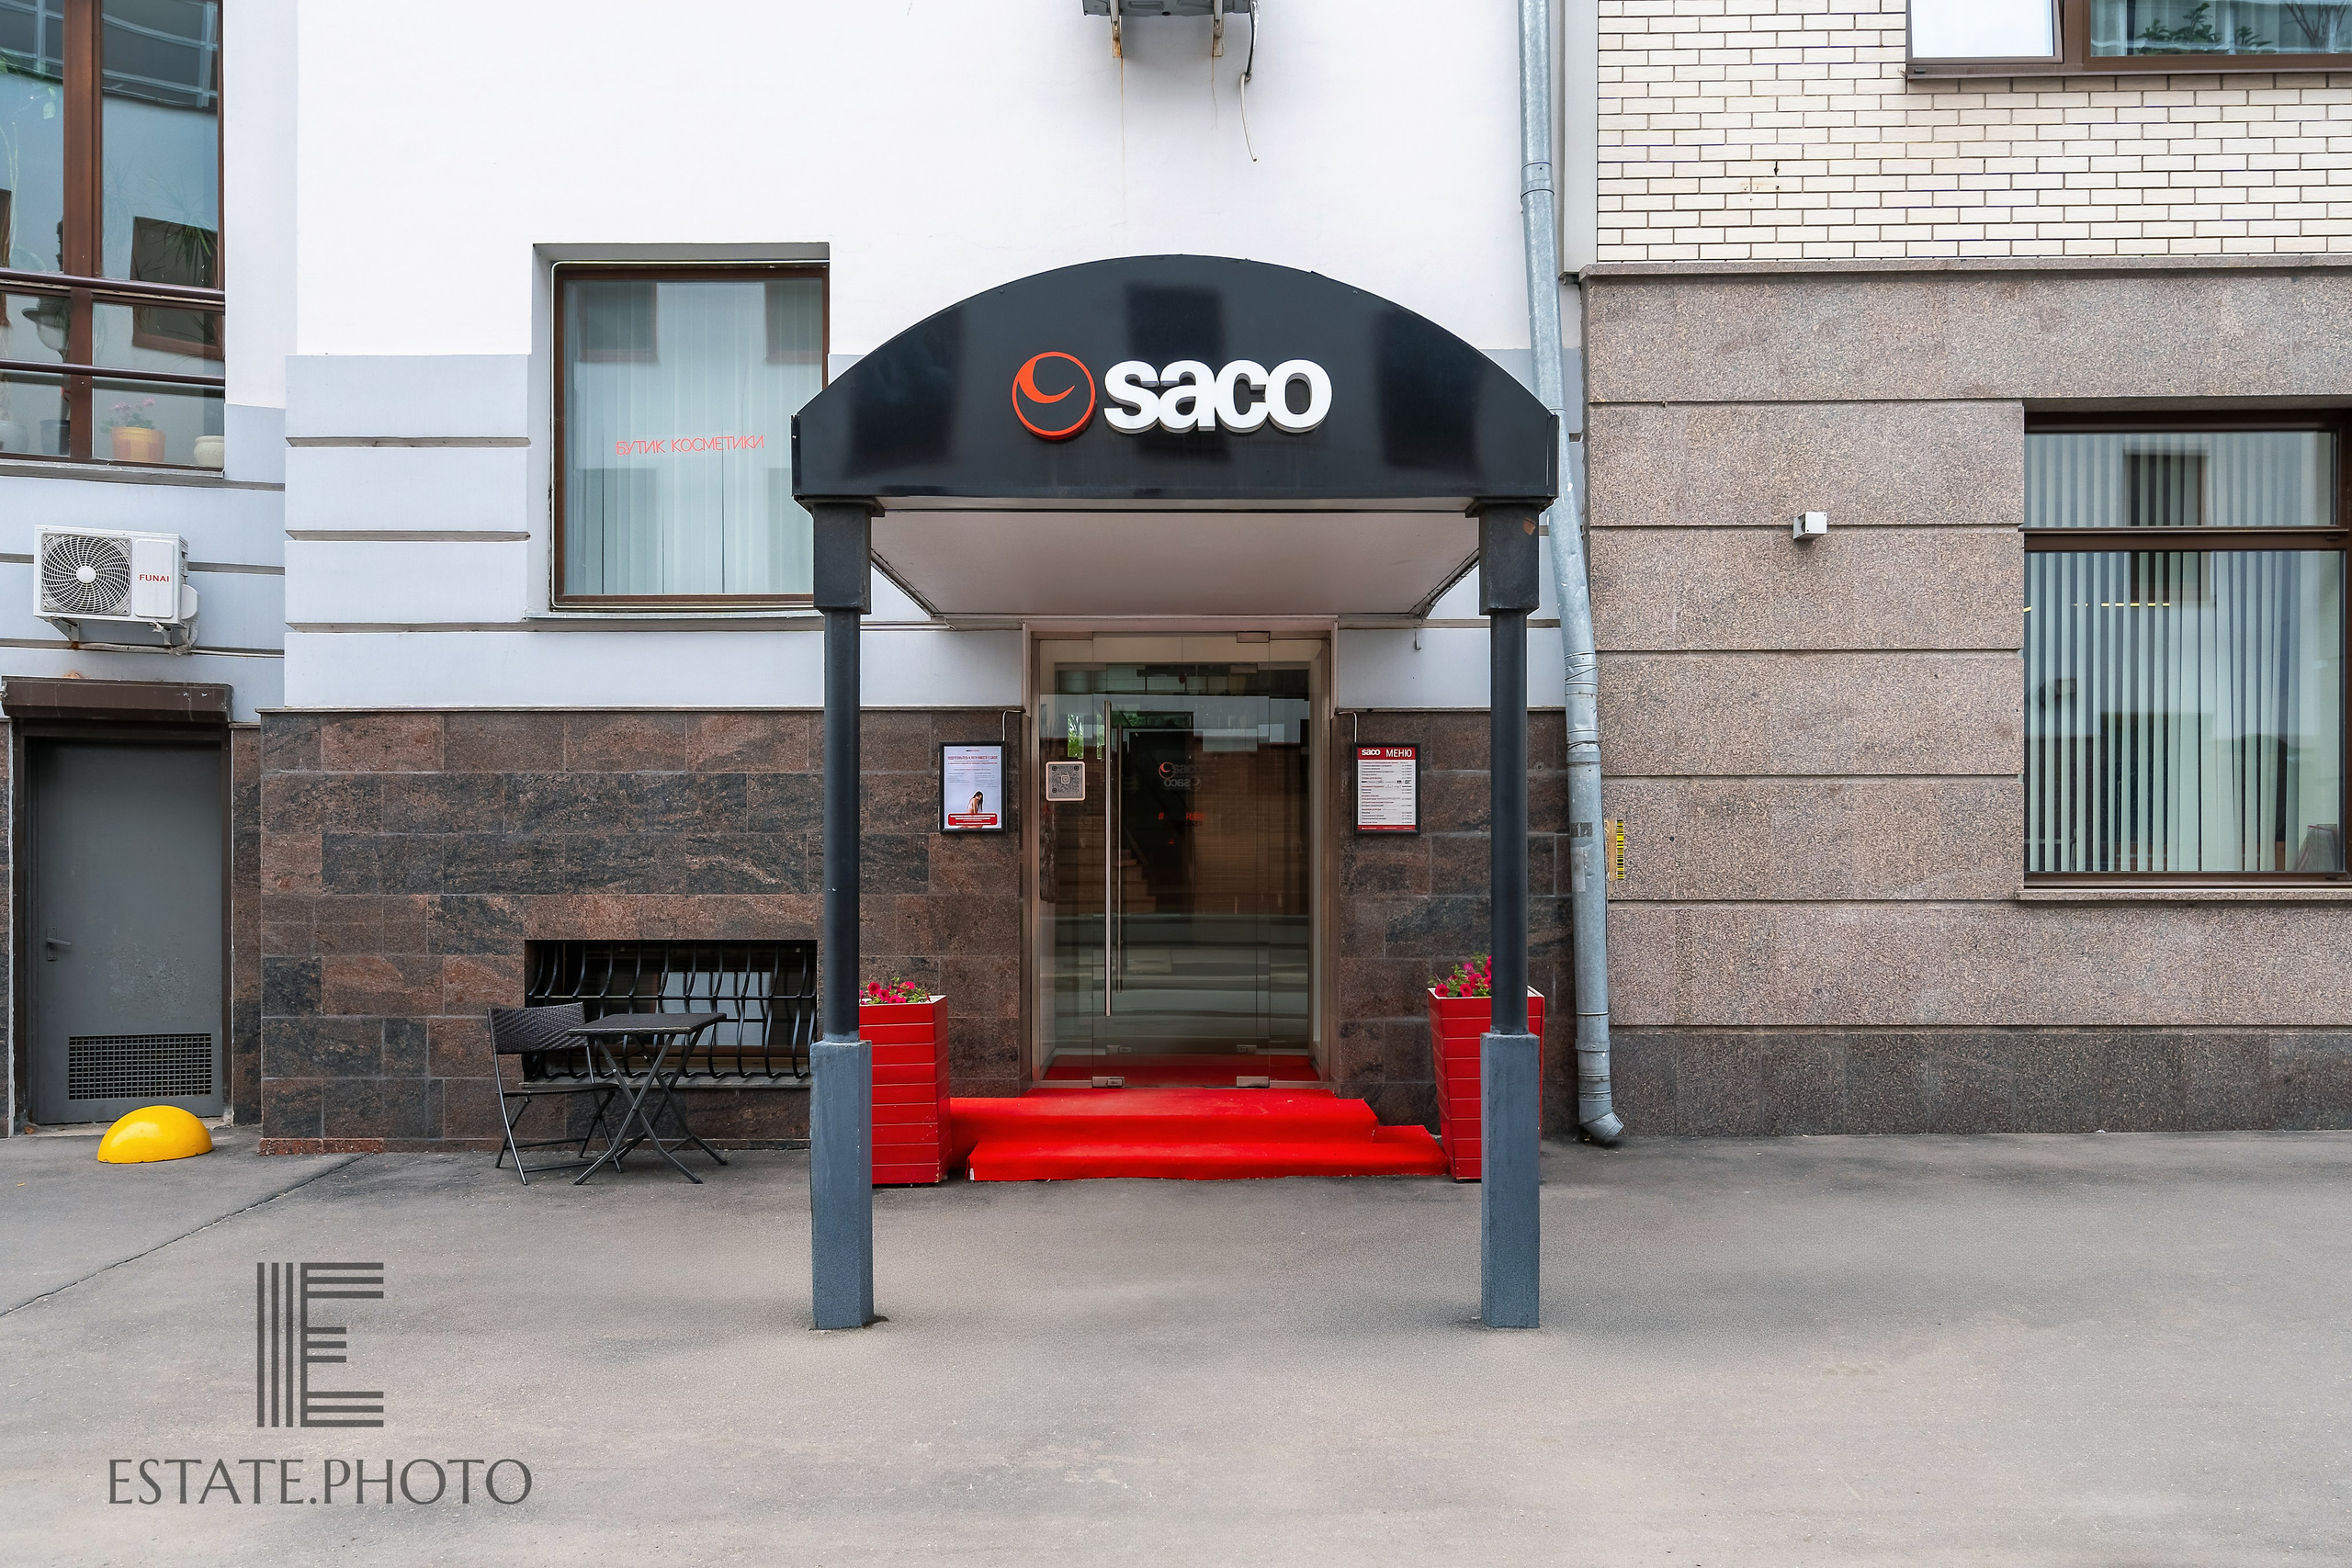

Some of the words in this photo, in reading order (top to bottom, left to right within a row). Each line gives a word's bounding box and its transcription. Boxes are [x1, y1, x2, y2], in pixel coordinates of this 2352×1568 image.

[1103, 359, 1332, 434] saco
[616, 440, 665, 456] БУТИК
[672, 434, 764, 453] КОСМЕТИКИ
[139, 574, 170, 582] FUNAI
[1385, 749, 1412, 758] МЕНЮ
